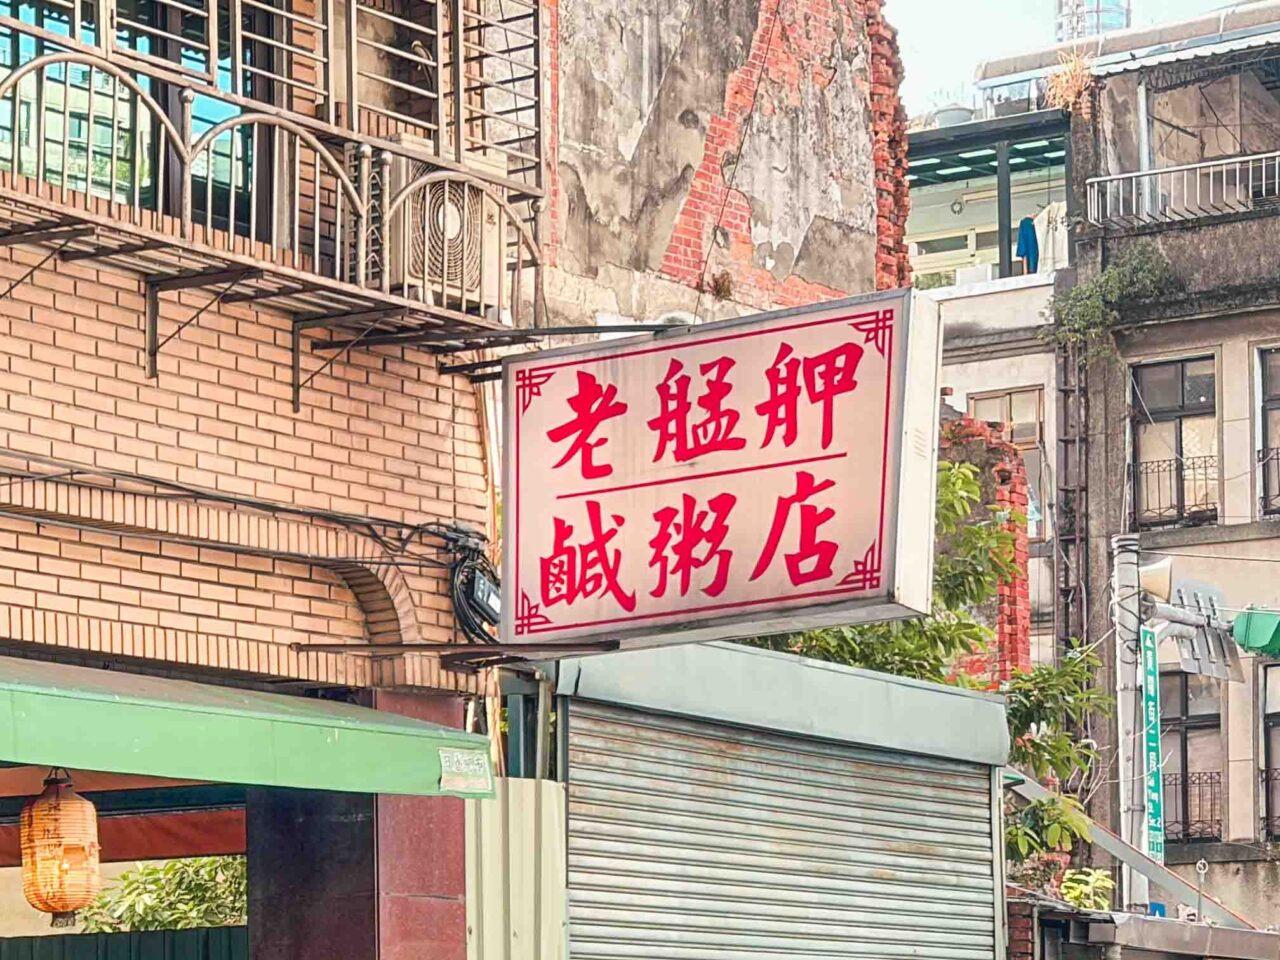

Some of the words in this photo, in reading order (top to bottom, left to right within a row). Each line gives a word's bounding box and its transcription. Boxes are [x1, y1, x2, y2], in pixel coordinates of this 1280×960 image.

[546, 341, 864, 481] 老艋舺
[539, 470, 841, 613] 鹹粥店
